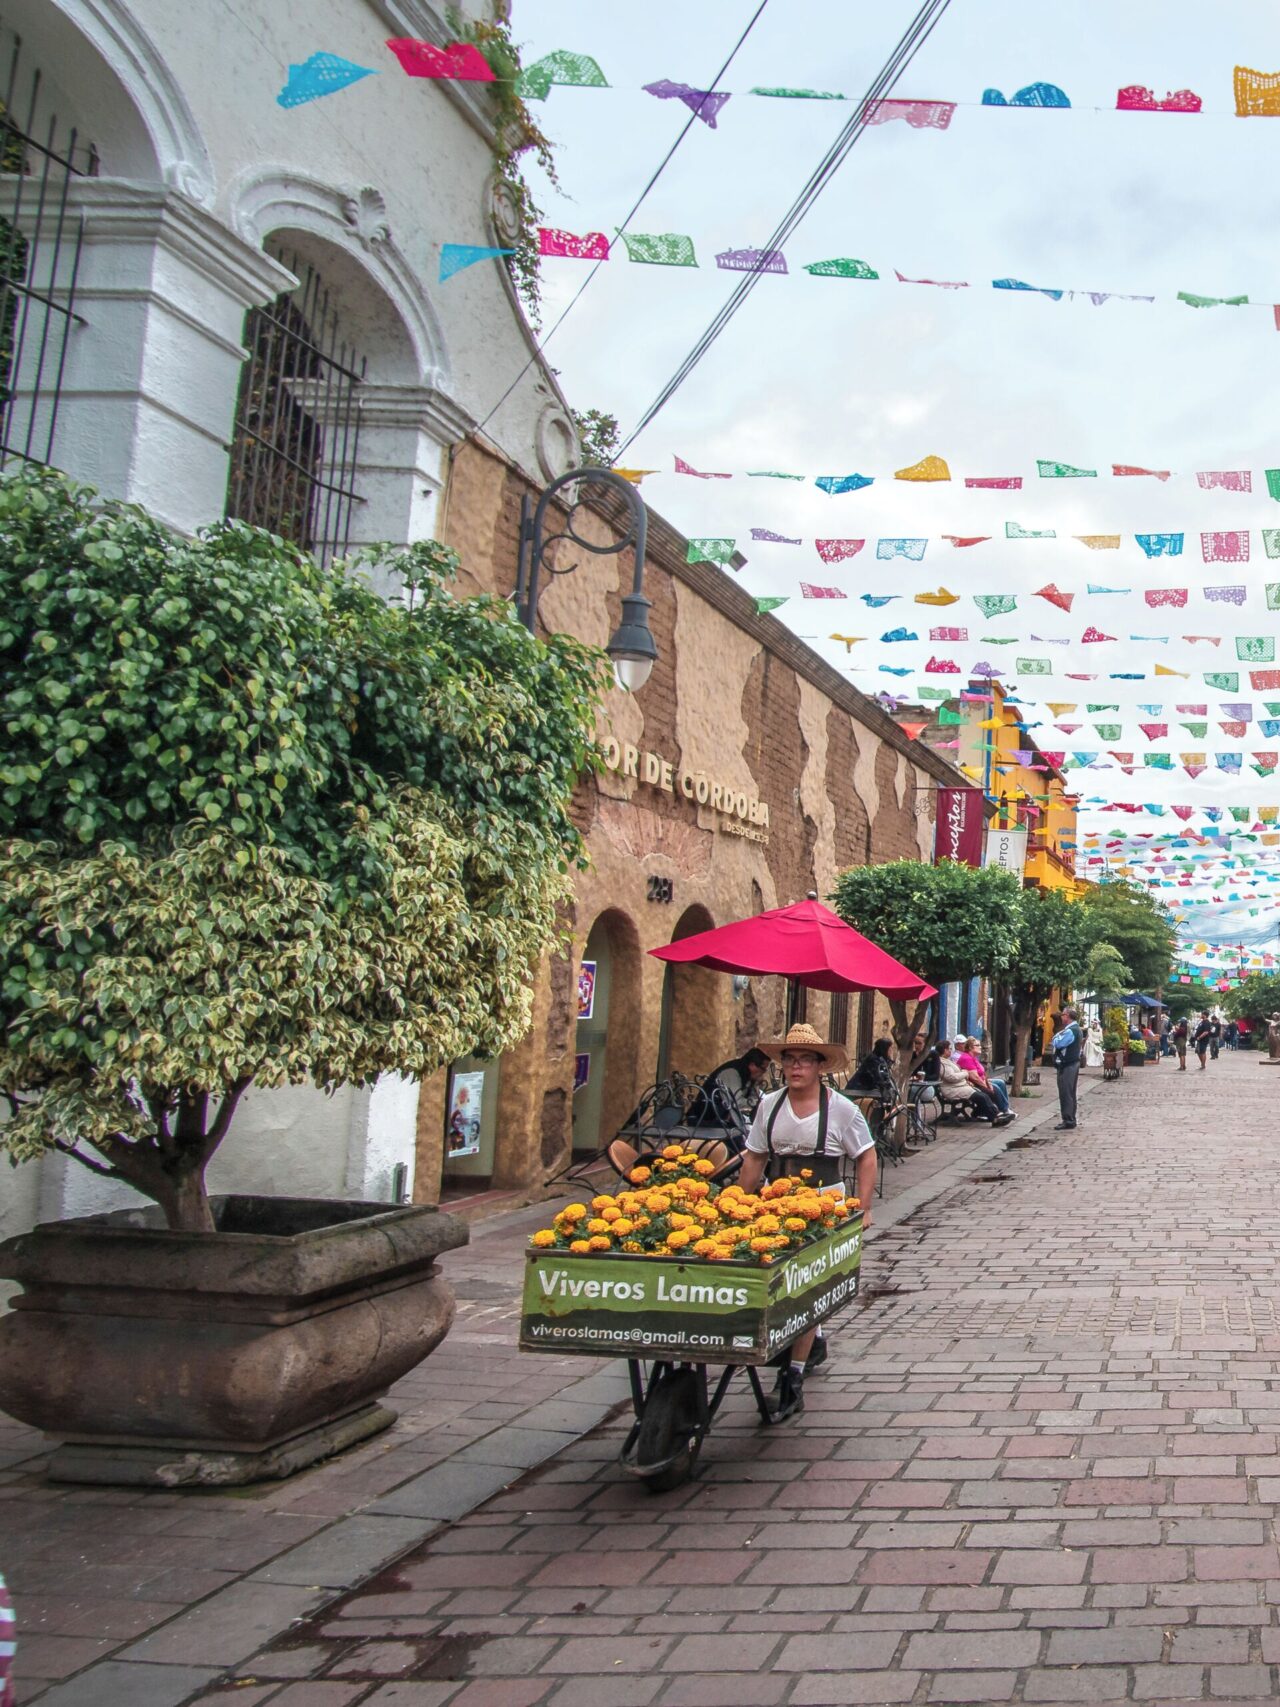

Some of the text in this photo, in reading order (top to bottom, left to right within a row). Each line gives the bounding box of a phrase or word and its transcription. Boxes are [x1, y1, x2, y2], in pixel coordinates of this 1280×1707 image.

[645, 752, 673, 793] DE
[726, 821, 750, 838] DESDE
[998, 836, 1010, 871] EPTOS
[784, 1234, 860, 1295] Viveros Lamas
[538, 1270, 749, 1307] Viveros Lamas
[531, 1324, 725, 1346] viveroslamas@gmail.com
[769, 1312, 809, 1348] Pedidos:
[813, 1292, 832, 1320] 3587
